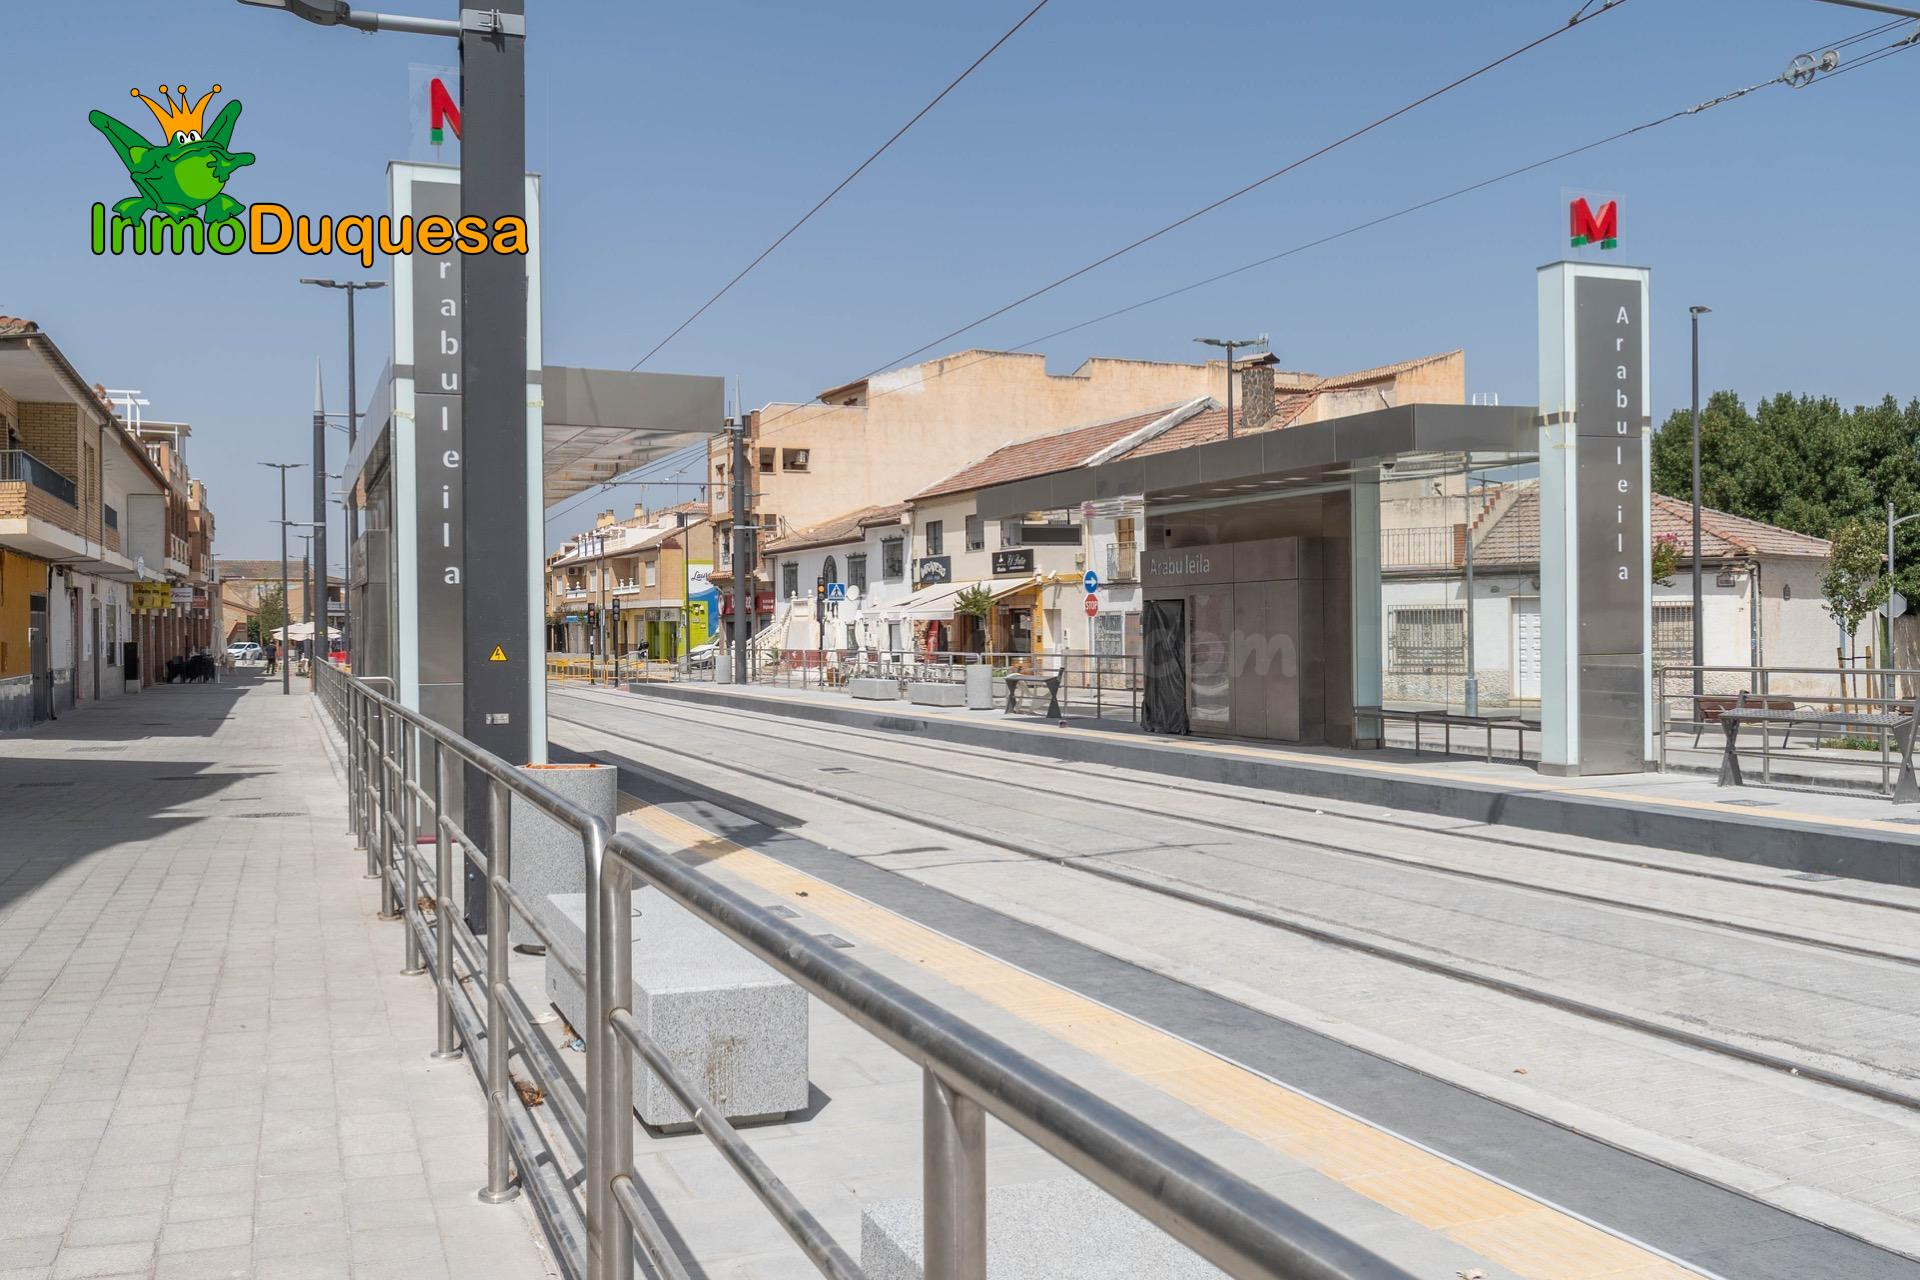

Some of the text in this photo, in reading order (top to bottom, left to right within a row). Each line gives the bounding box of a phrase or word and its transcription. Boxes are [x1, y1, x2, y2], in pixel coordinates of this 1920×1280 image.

[1569, 197, 1617, 250] M
[1616, 307, 1629, 579] Arabuleila
[1085, 601, 1098, 610] STOP
